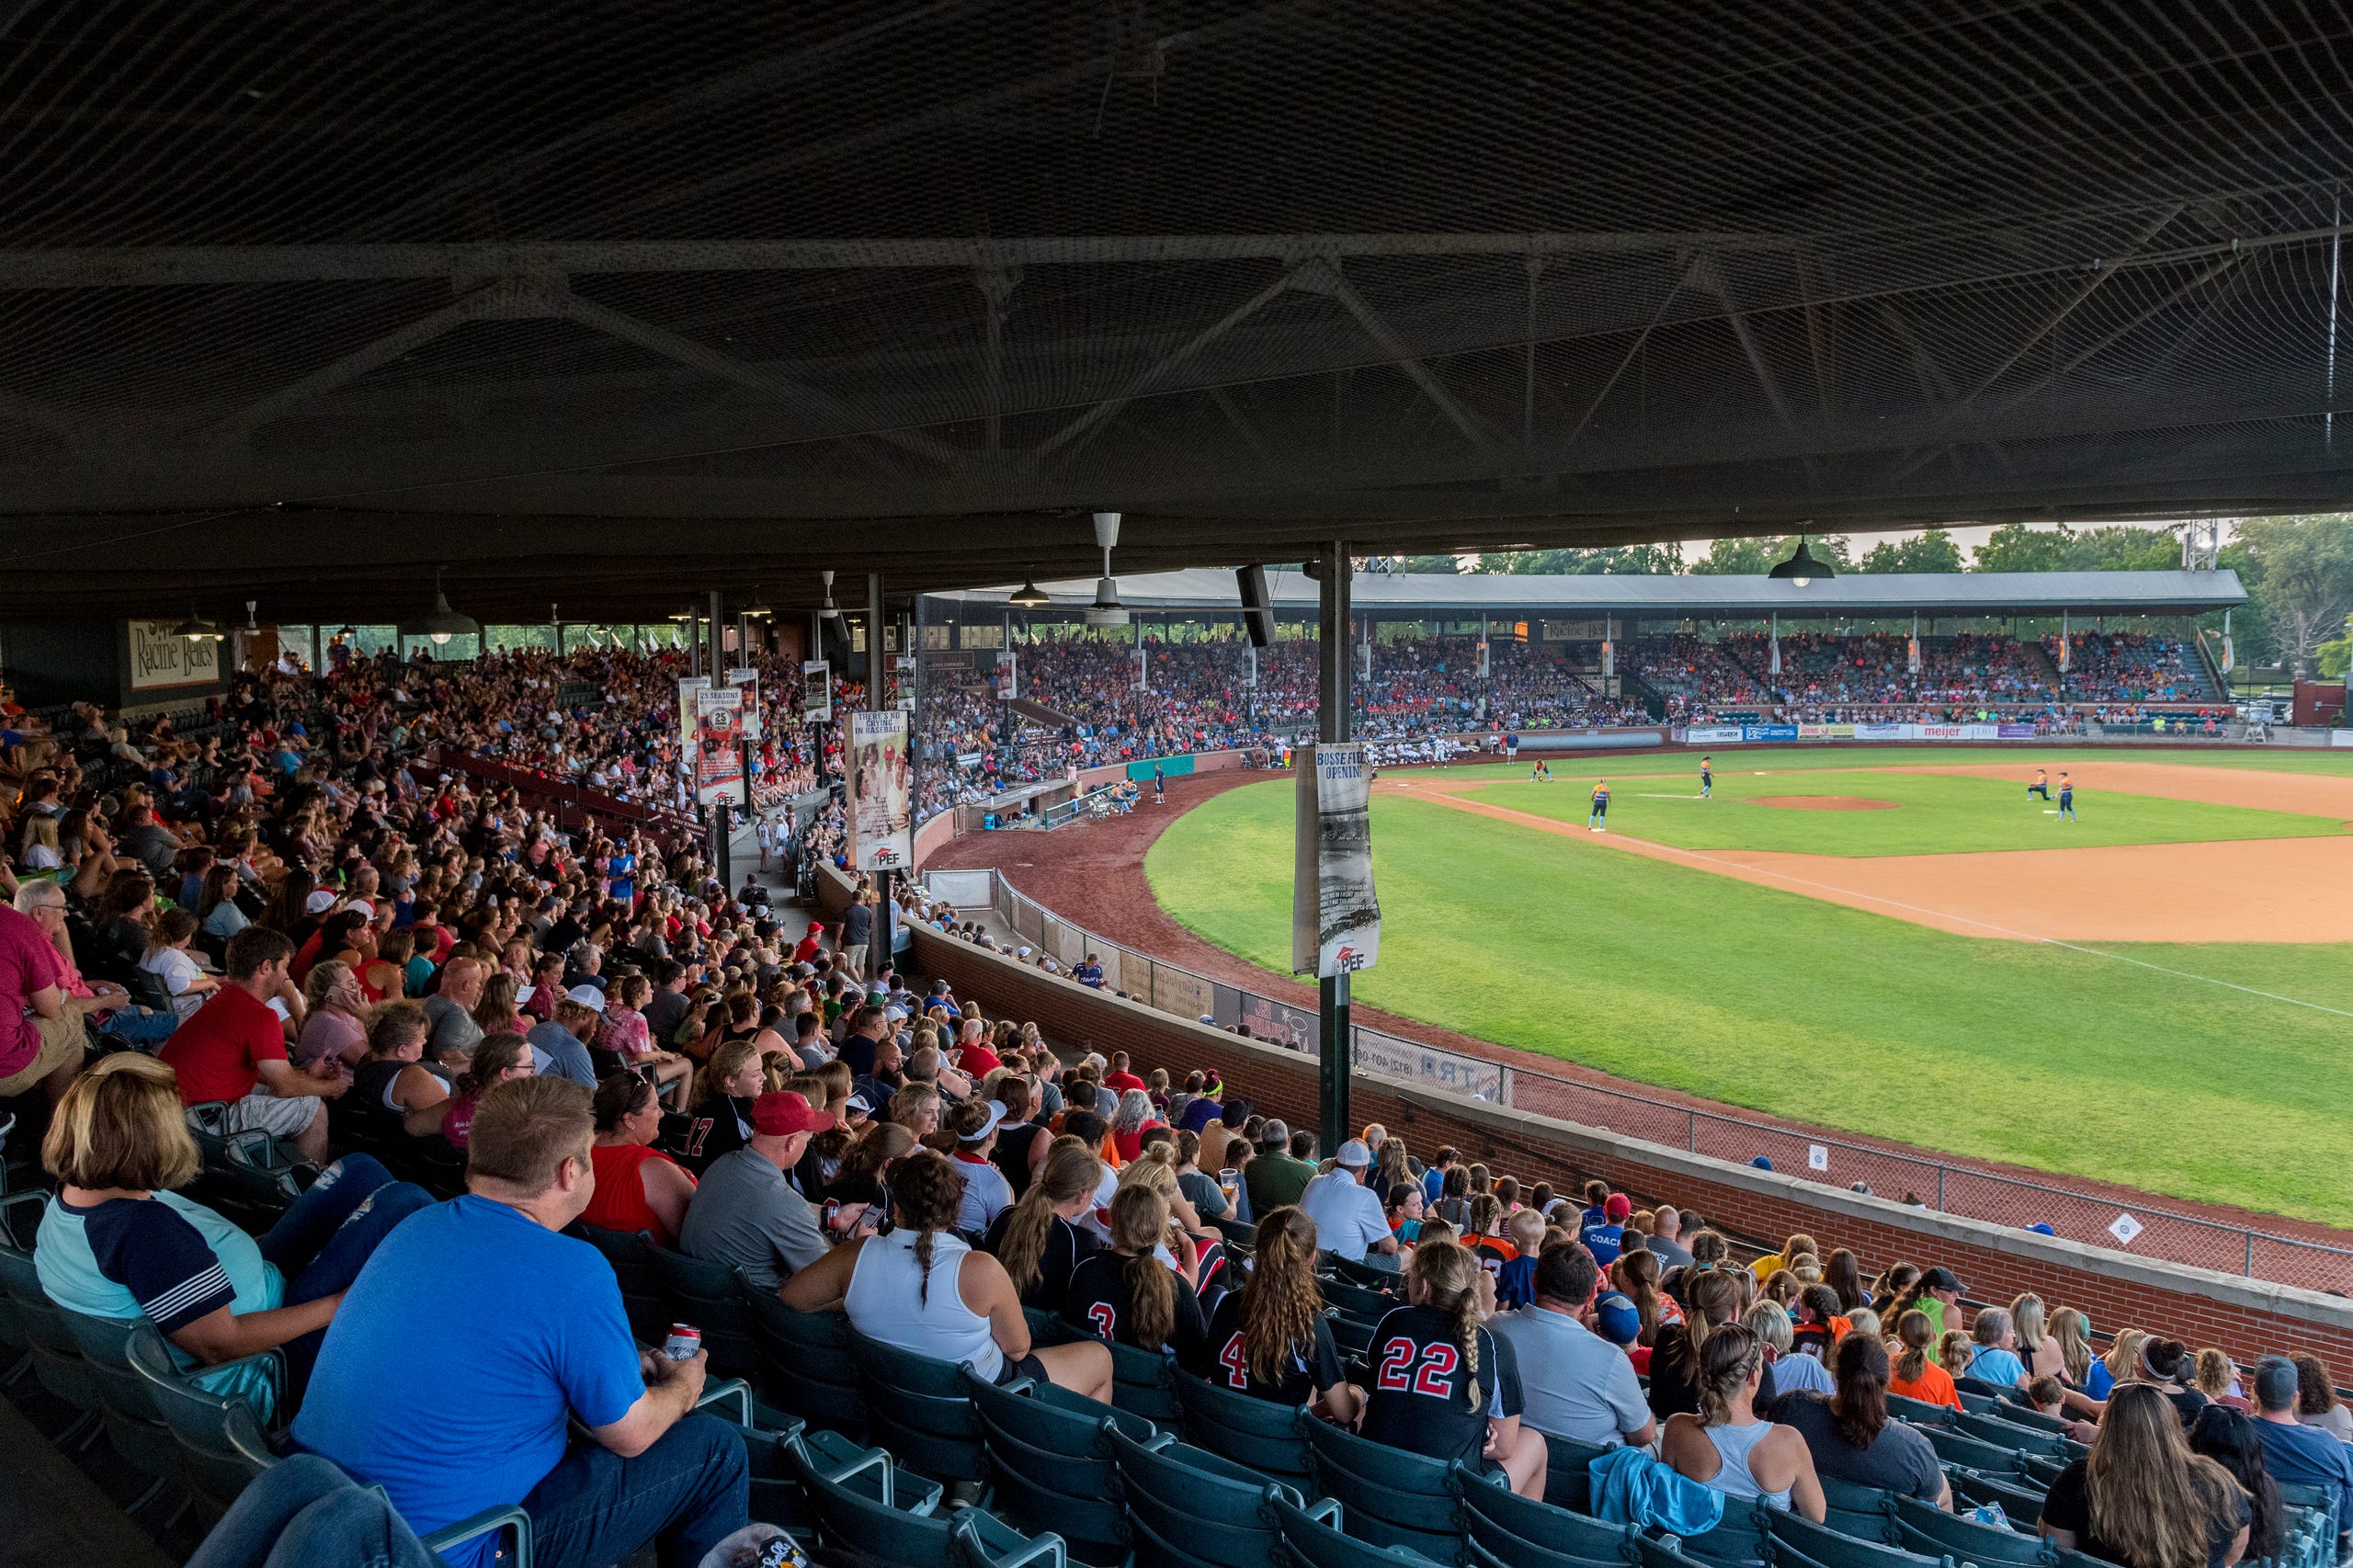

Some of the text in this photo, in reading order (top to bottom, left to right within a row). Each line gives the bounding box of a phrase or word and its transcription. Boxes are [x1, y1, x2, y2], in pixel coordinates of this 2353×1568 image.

[136, 628, 177, 677] Racine
[183, 633, 212, 676] Belles
[715, 712, 726, 722] 25
[866, 725, 903, 733] BASEBALL!
[1925, 726, 1961, 738] meijer
[1317, 752, 1369, 766] BOSSE FIEL
[718, 796, 735, 804] PEF
[879, 853, 899, 867] PEF
[1342, 954, 1364, 972] PEF
[684, 1117, 714, 1157] 17
[1088, 1301, 1116, 1341] 3
[1377, 1336, 1460, 1401] 22
